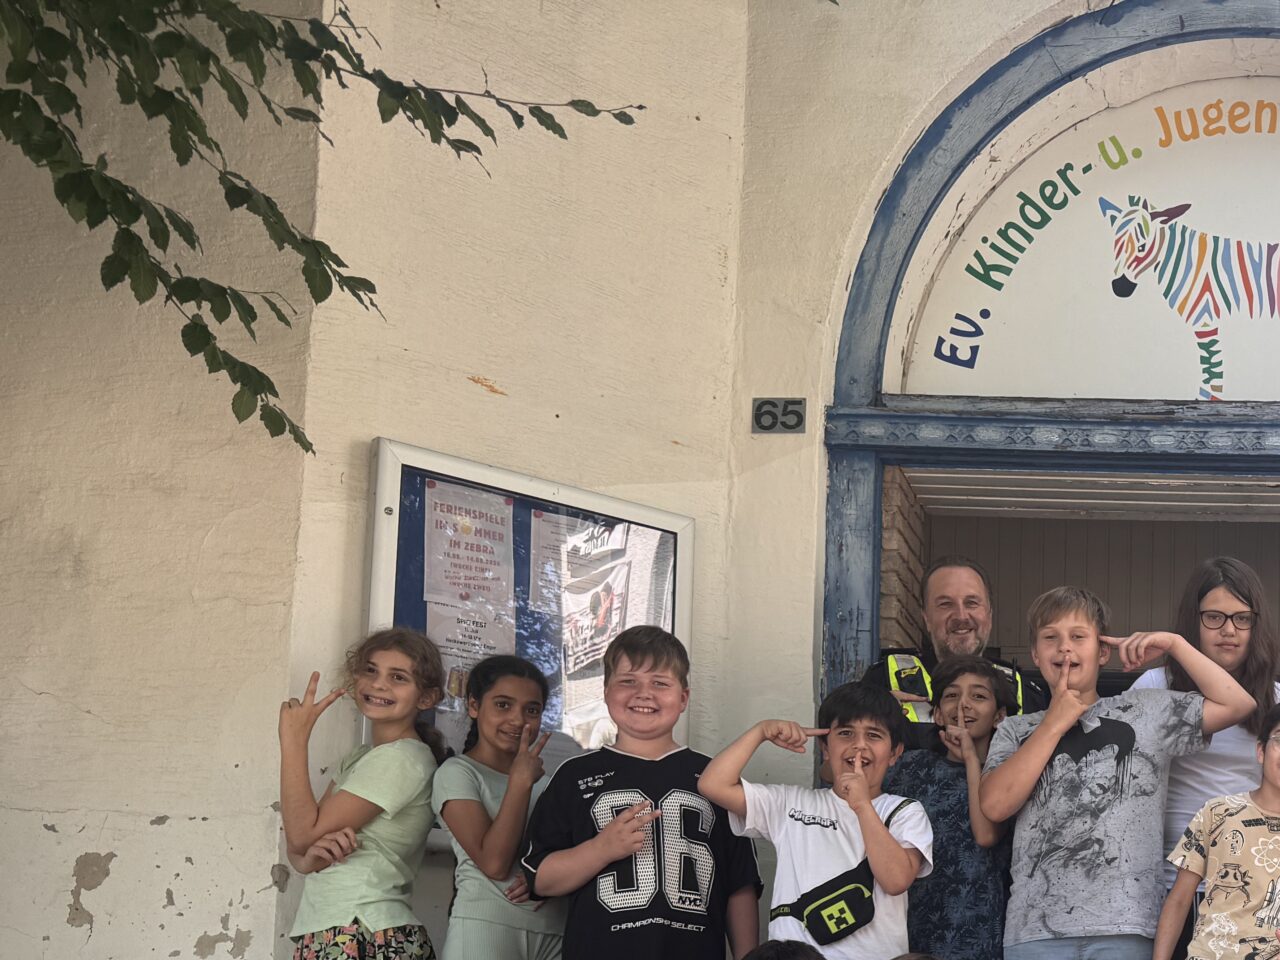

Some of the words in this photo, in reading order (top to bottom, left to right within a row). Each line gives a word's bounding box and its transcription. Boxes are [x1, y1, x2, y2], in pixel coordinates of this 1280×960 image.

[933, 307, 991, 369] Ev.
[1097, 134, 1143, 170] u.
[754, 400, 804, 430] 65
[433, 501, 507, 527] FERIENSPIELE
[449, 539, 461, 548] IM
[464, 542, 495, 555] ZEBRA
[670, 921, 706, 932] SELECT
